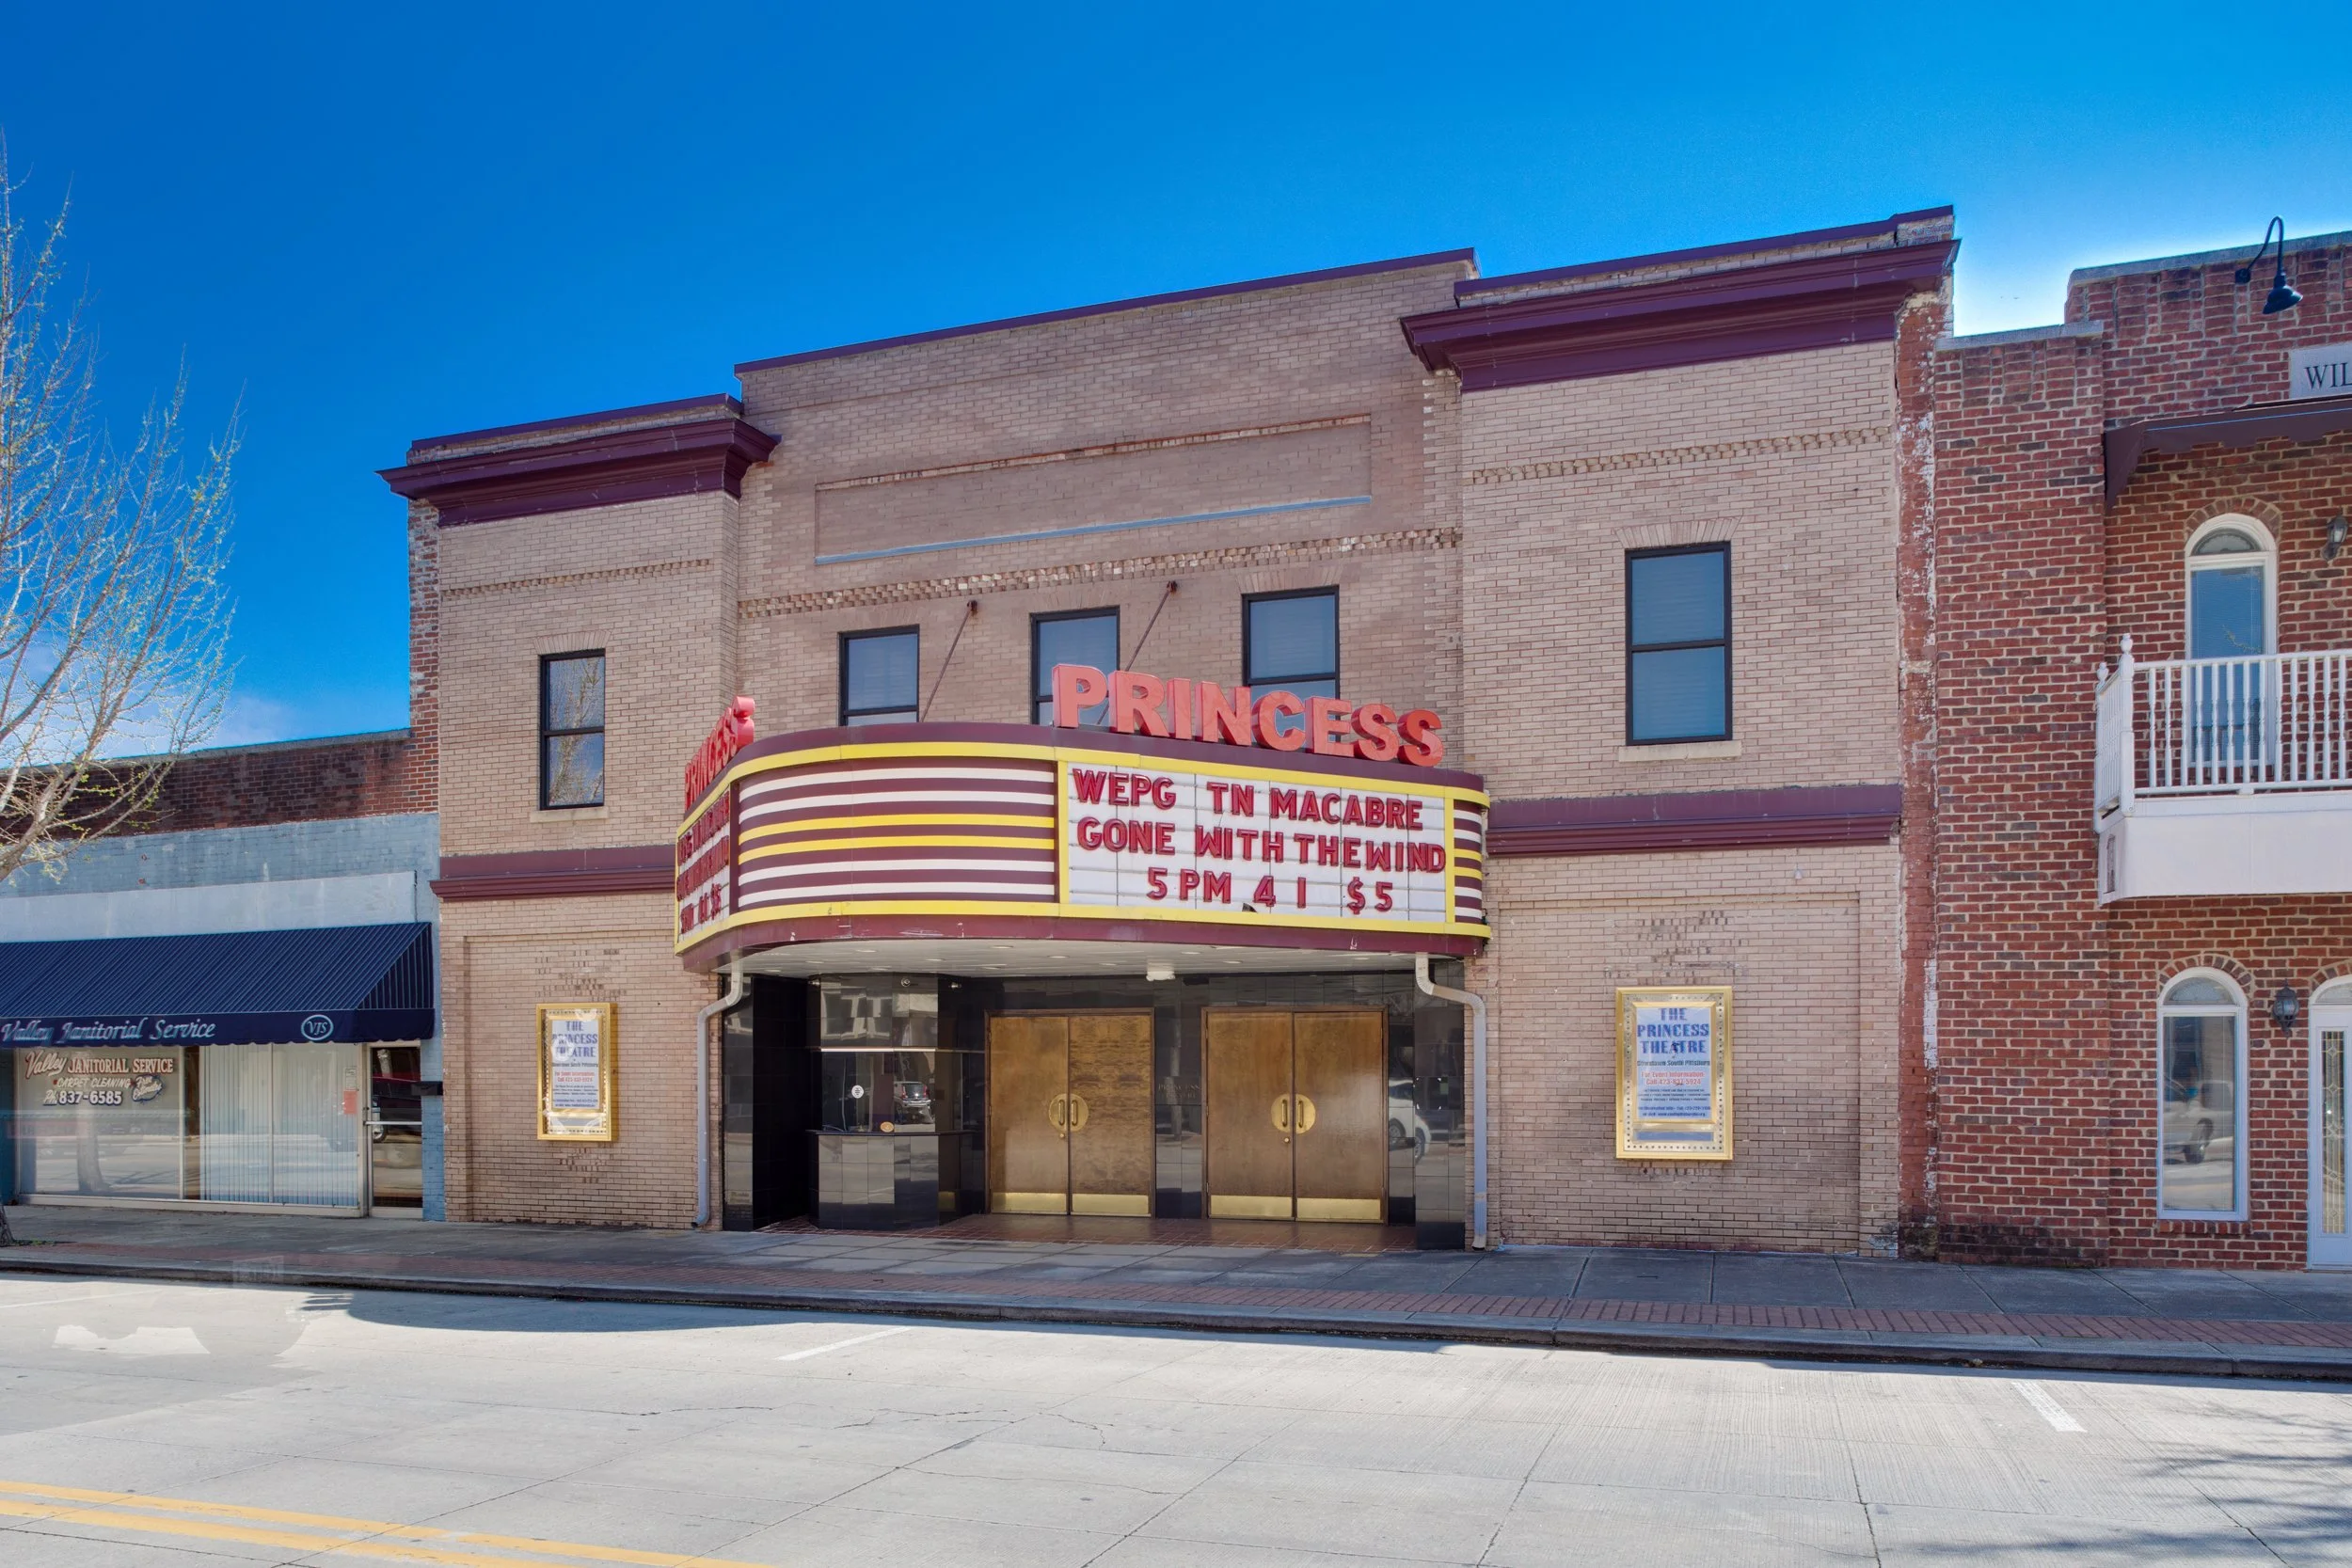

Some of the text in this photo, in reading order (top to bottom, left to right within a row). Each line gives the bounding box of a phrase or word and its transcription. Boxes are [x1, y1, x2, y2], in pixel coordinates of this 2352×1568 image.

[1052, 664, 1445, 768] PRINCESS
[1073, 768, 1423, 832] WEPG TN MACABRE
[1077, 816, 1175, 856] GONE
[1195, 825, 1284, 863] WITH
[1146, 866, 1168, 901] 5
[1179, 868, 1232, 904] PM
[1659, 1007, 1688, 1021] THE
[1, 1017, 216, 1044] Valley Janitorial Service
[565, 1021, 583, 1032] THE
[1637, 1023, 1709, 1037] PRINCESS
[1640, 1039, 1708, 1054] THEATRE
[25, 1049, 174, 1079] Valley JANITORIAL SERVICE
[56, 1078, 131, 1089] CARPET CLEANING
[58, 1090, 123, 1105] 837-6585
